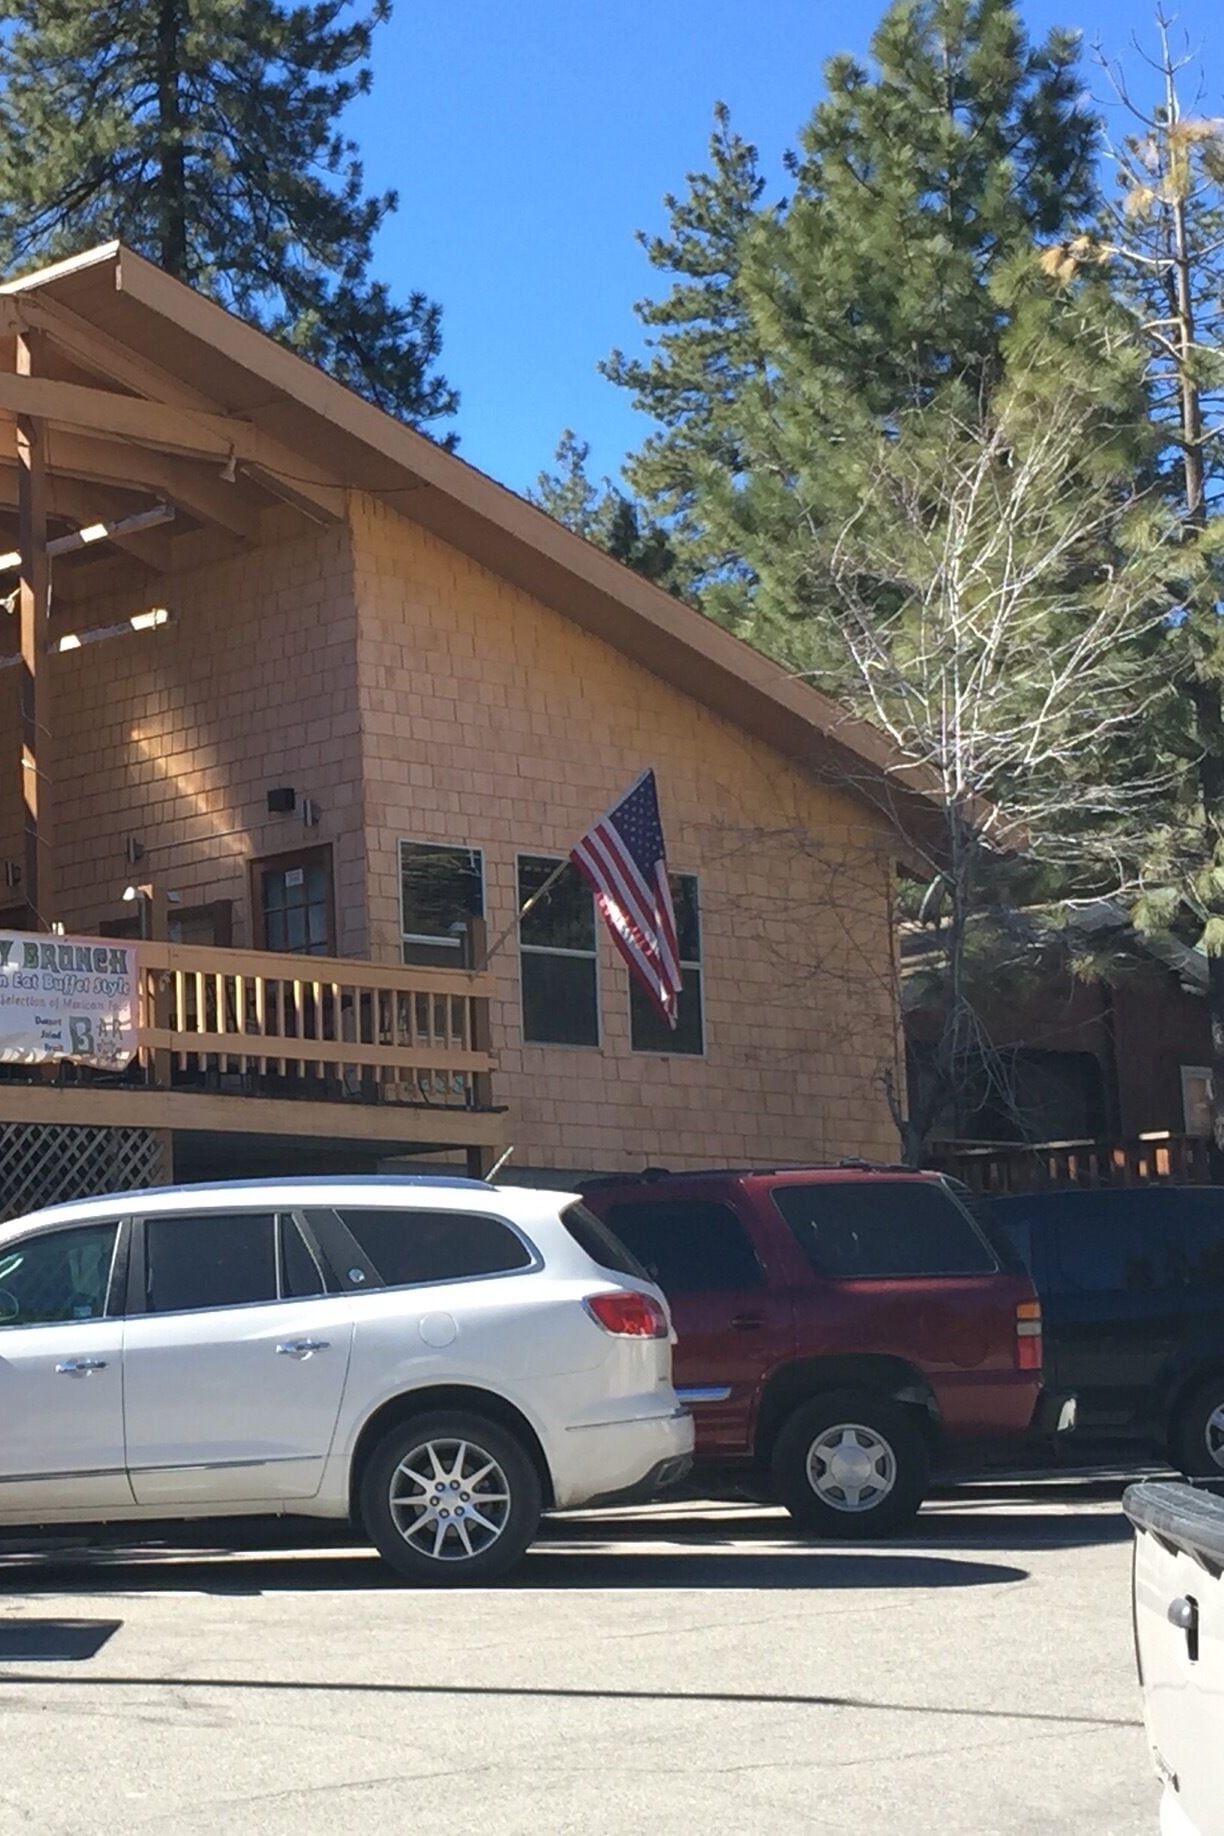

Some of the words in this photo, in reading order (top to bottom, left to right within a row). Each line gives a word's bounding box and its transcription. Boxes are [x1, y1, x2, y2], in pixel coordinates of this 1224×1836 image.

[22, 942, 129, 975] BRUNCH
[13, 972, 40, 991] Eat
[42, 973, 91, 996] Buffet
[92, 978, 131, 998] Style
[0, 994, 46, 1009] Selection
